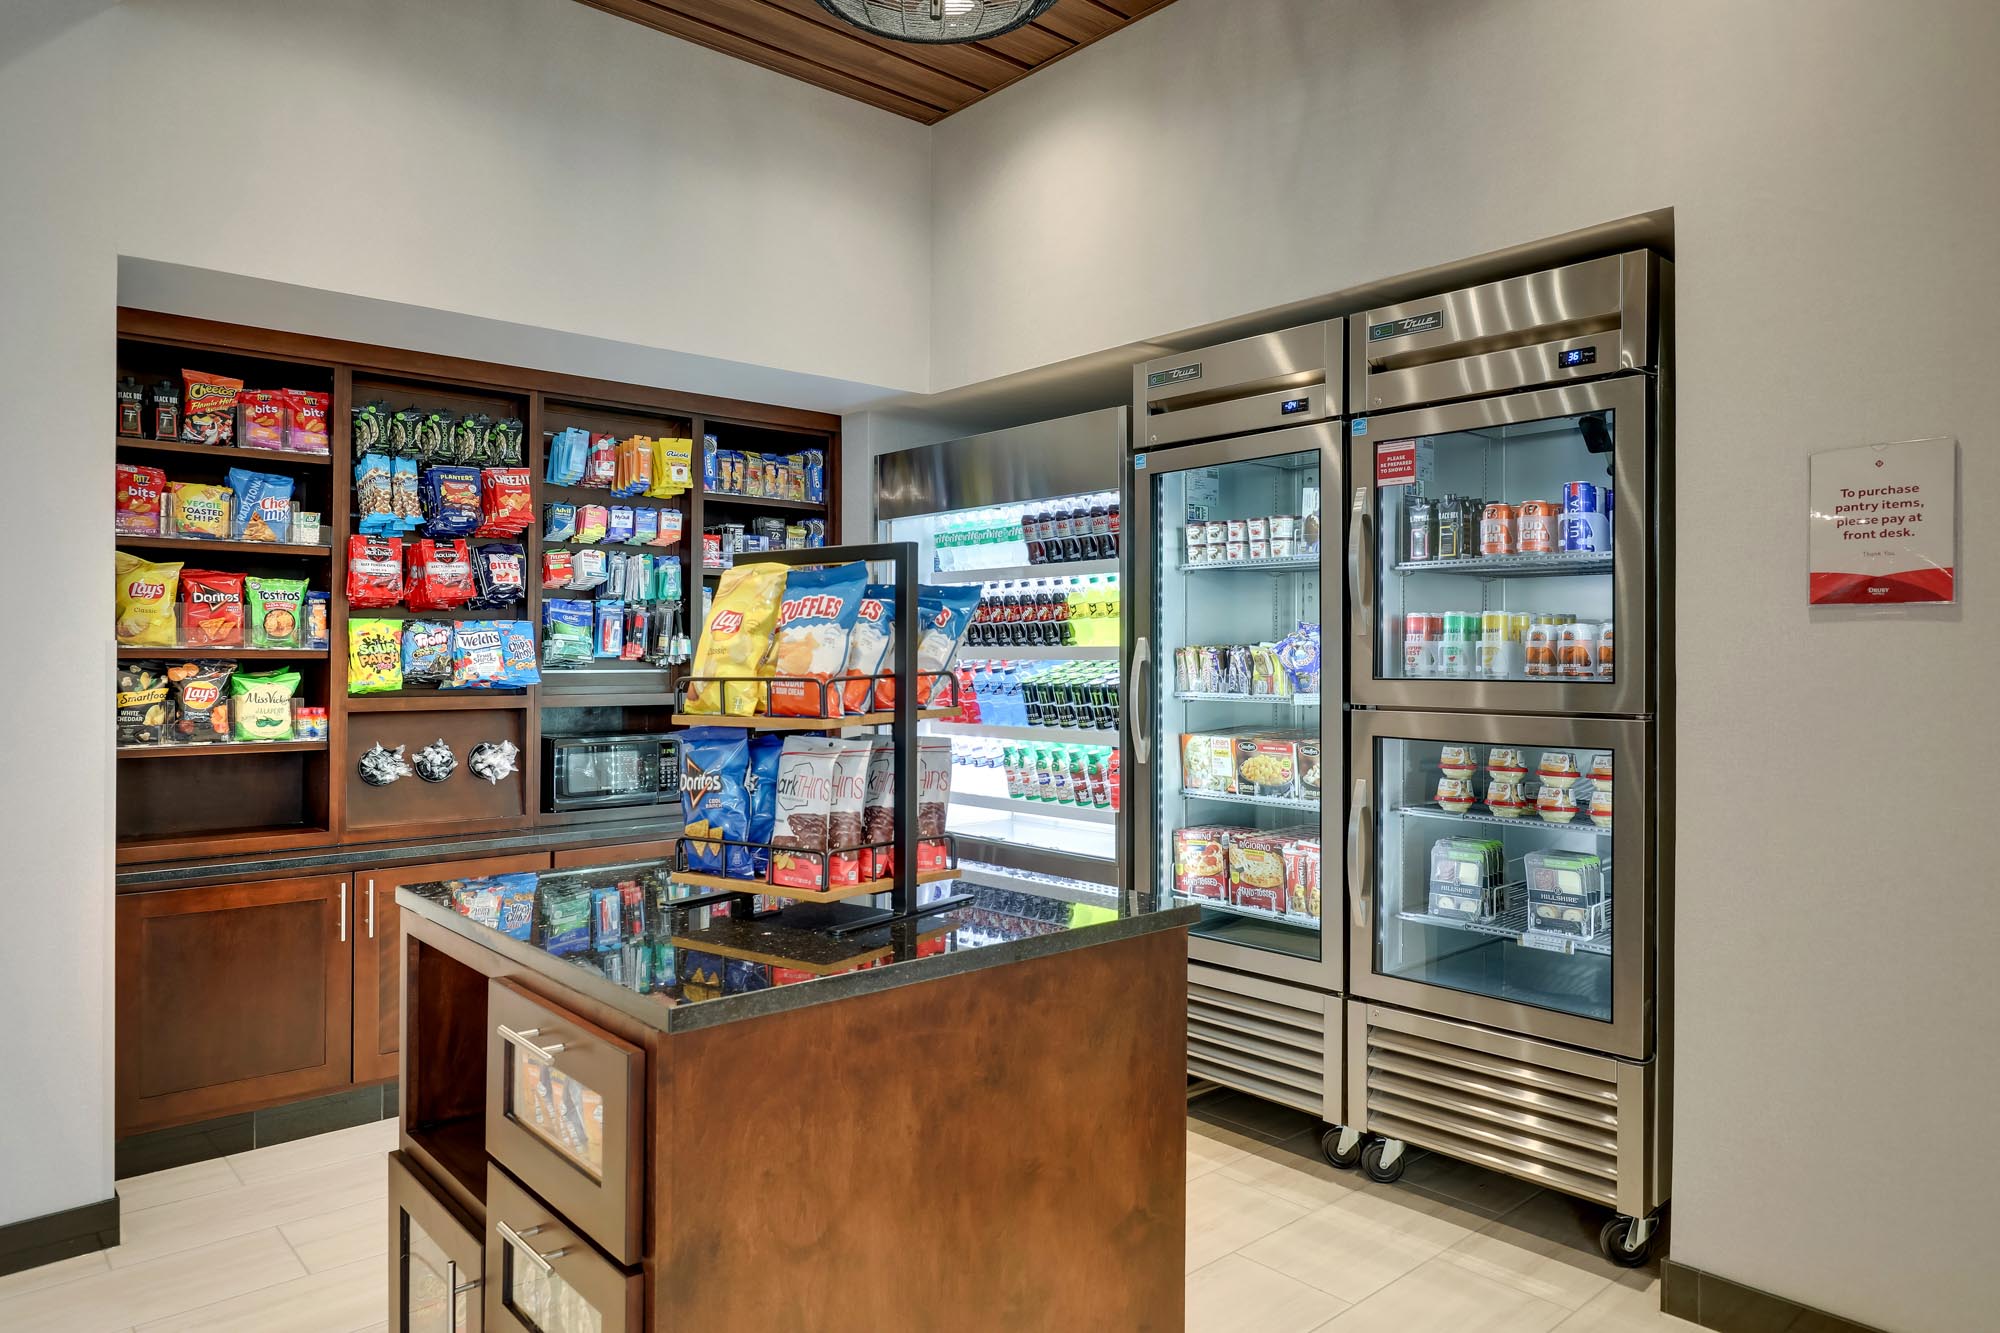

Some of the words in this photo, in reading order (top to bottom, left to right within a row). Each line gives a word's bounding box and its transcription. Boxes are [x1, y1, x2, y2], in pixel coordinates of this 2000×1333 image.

[1568, 351, 1579, 362] 36
[191, 384, 236, 398] Cheetos
[303, 397, 318, 405] RITZ
[255, 404, 278, 413] bits
[302, 408, 325, 417] bits
[133, 473, 150, 483] RITZ
[494, 475, 530, 485] CHEEZ-IT
[128, 486, 156, 497] bits
[1840, 488, 1855, 498] To
[1858, 484, 1920, 500] purchase
[186, 499, 222, 509] VEGGIE
[261, 497, 291, 510] Chex
[1835, 501, 1879, 515] pantry
[1881, 499, 1924, 510] items,
[181, 506, 224, 517] TOASTED
[264, 508, 290, 522] mix
[185, 515, 220, 524] CHIPS
[1569, 499, 1580, 538] ULTRA
[1836, 517, 1879, 529] please
[1881, 515, 1905, 527] pay
[1908, 512, 1923, 522] at
[1521, 530, 1547, 540] IGHT
[1843, 529, 1876, 540] front
[1879, 527, 1915, 538] desk.
[490, 562, 519, 570] BITES
[193, 592, 240, 603] Doritos
[259, 590, 300, 600] TOSTITOS
[782, 595, 842, 625] RUFFLES
[414, 631, 448, 648] Trolli
[461, 633, 500, 647] Welch's
[359, 643, 396, 655] SOUR
[509, 640, 529, 652] Chips
[360, 653, 399, 666] PATCH
[185, 687, 216, 702] Lay's
[680, 773, 721, 792] Doritos
[1440, 885, 1473, 895] HILLSHIRE
[1540, 893, 1578, 904] HILLSHIRE
